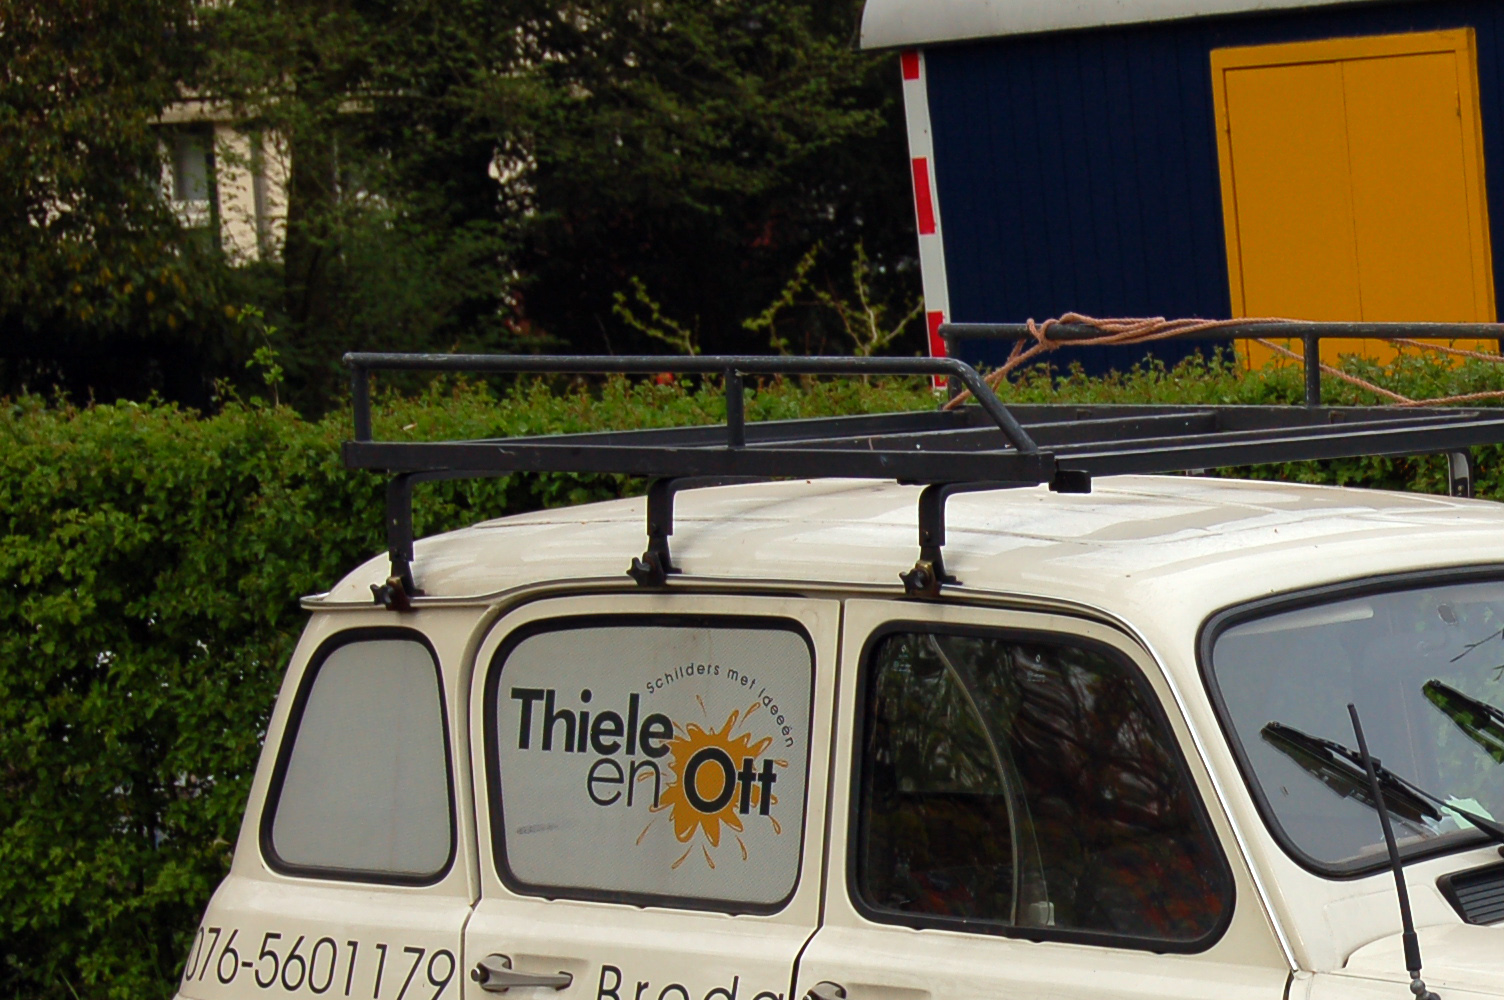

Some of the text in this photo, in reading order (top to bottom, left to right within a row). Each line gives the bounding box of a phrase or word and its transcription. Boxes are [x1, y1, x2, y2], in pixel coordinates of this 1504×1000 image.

[646, 662, 720, 694] schilders
[727, 668, 756, 690] met
[510, 686, 674, 758] Thiele
[587, 746, 777, 816] en Ott
